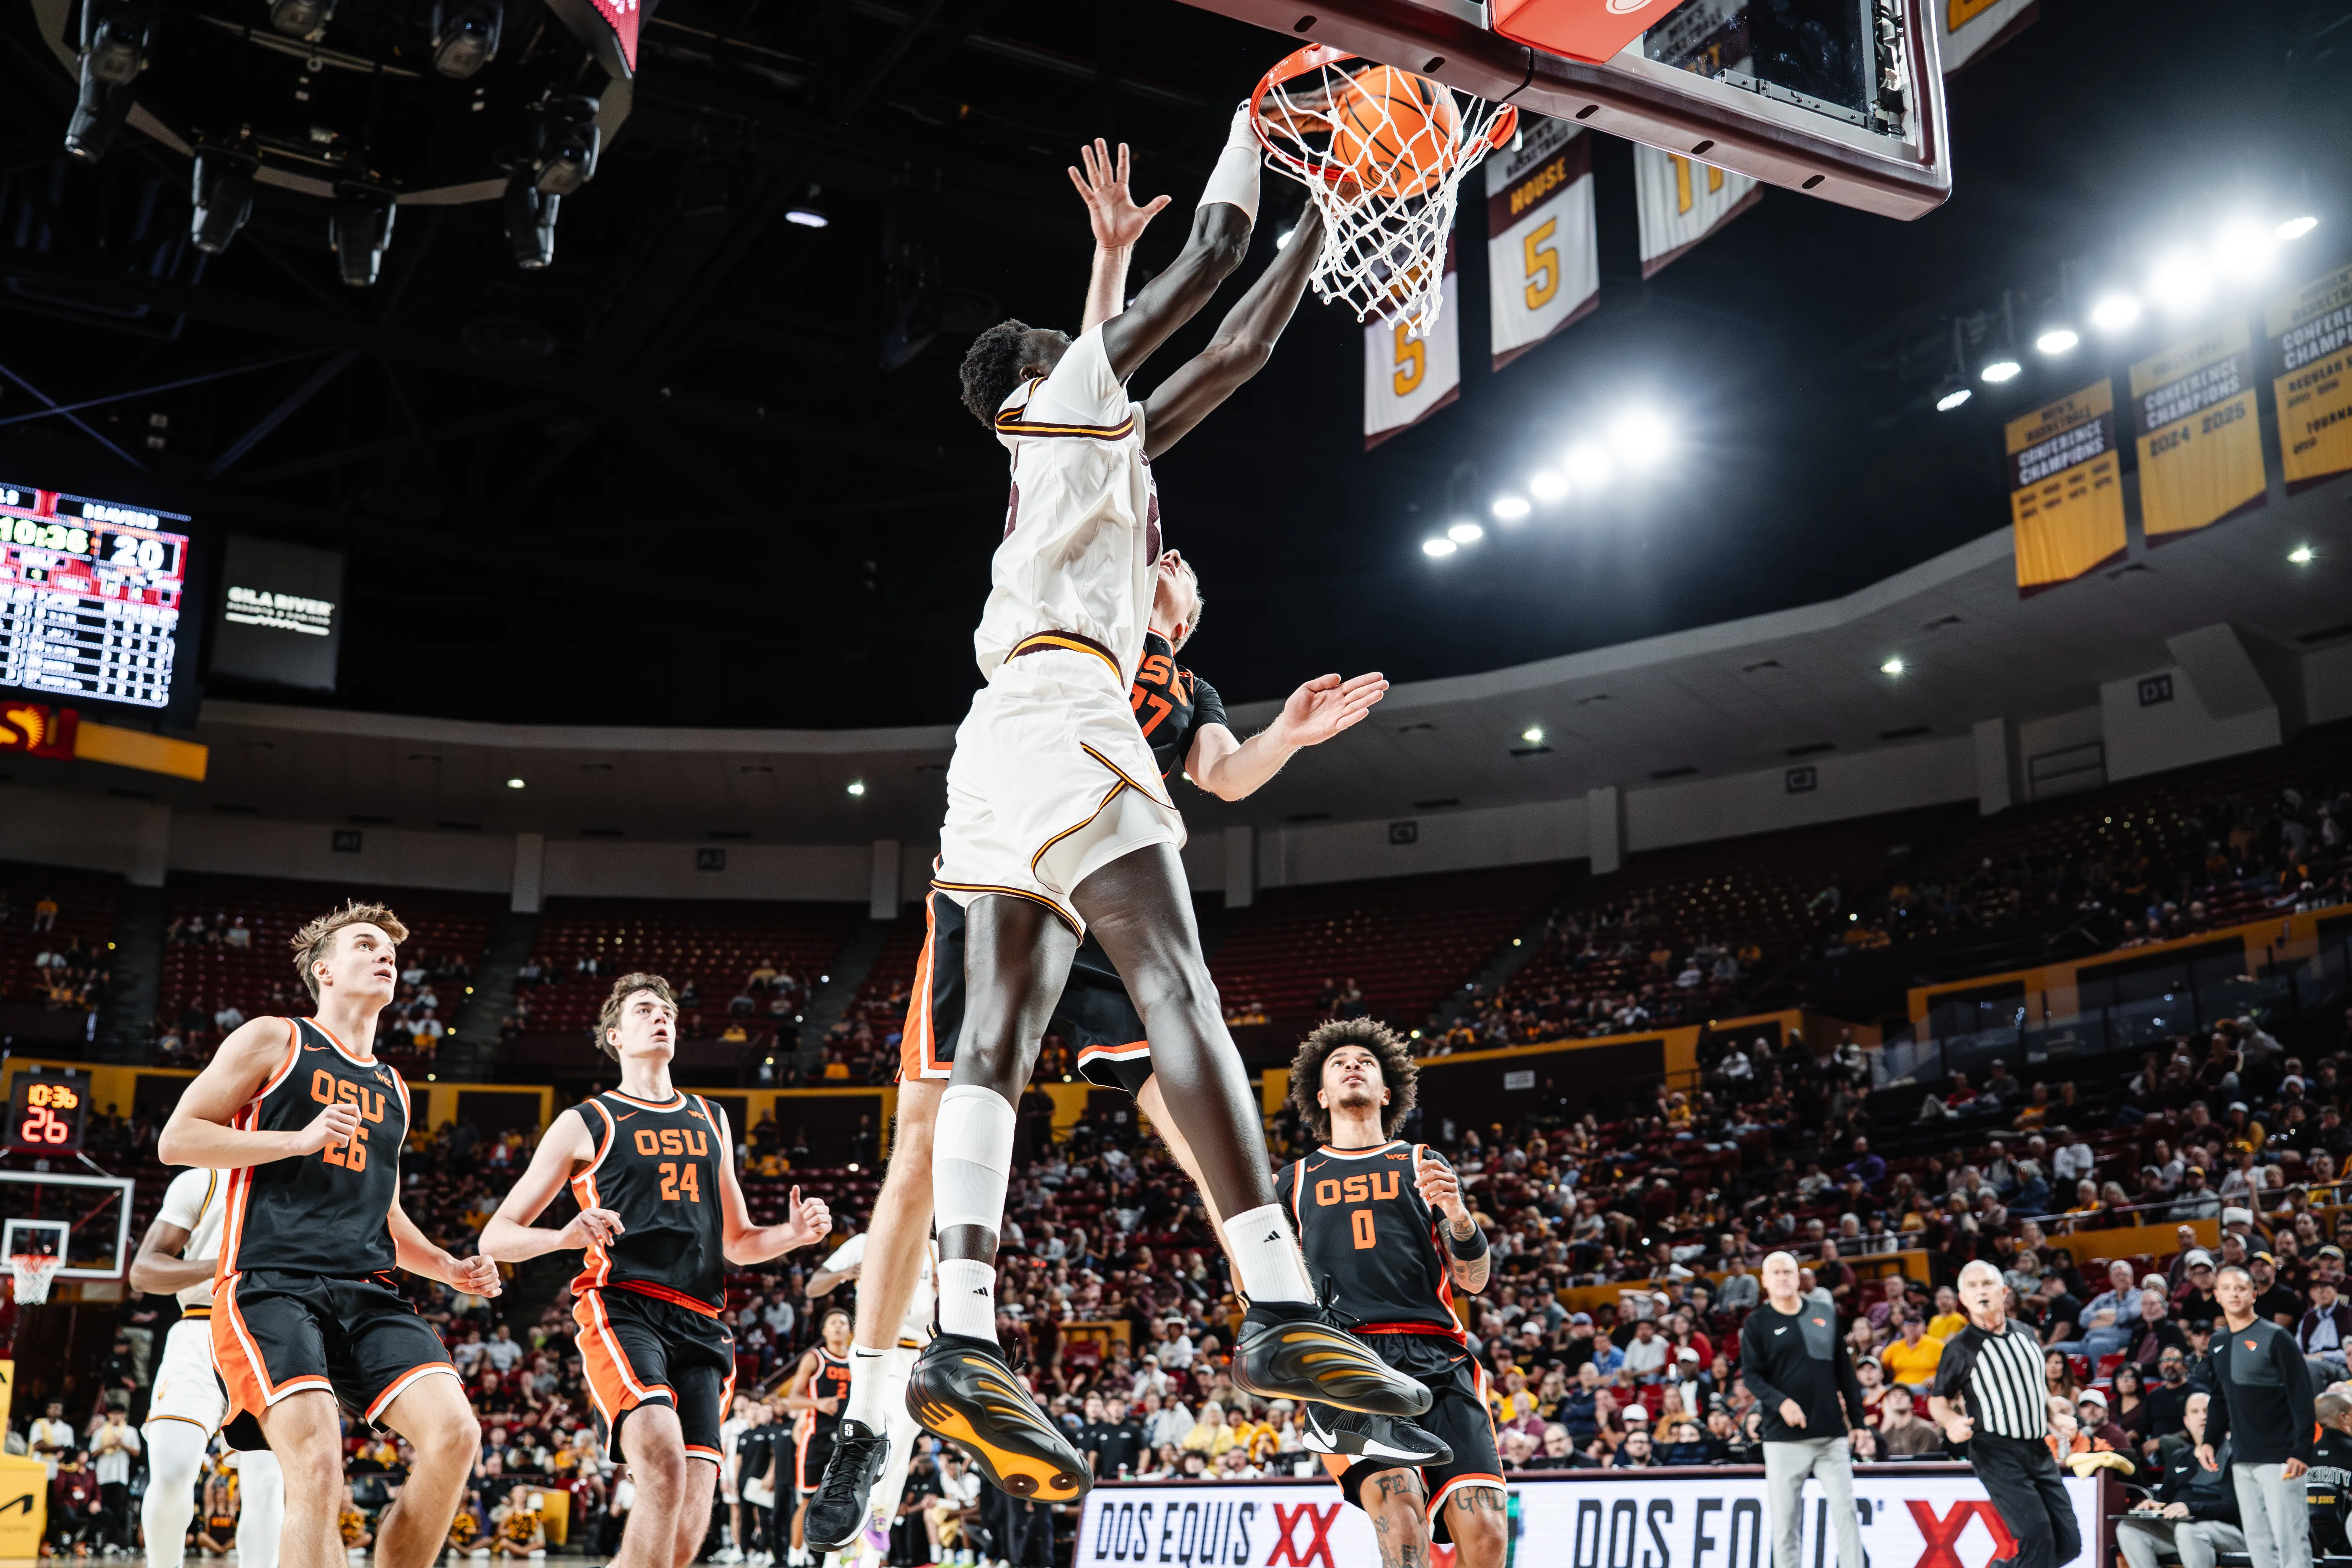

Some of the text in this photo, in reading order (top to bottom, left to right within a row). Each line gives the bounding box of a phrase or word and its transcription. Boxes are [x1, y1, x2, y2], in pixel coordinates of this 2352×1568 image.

[1524, 216, 1560, 310] 5
[1393, 312, 1425, 396] 5
[2146, 376, 2241, 430] CHAMPIONS
[111, 535, 164, 571] 20
[227, 586, 331, 617] GILA RIVER
[1136, 649, 1188, 706] SU
[310, 1069, 385, 1124] OSU
[22, 1106, 68, 1144] 26
[634, 1129, 708, 1156] OSU
[659, 1162, 700, 1203] 24
[1315, 1171, 1400, 1206] OSU
[1351, 1209, 1376, 1250] 0
[1095, 1502, 1343, 1568] DOS EQUIS XX
[1574, 1498, 1673, 1568] DOS
